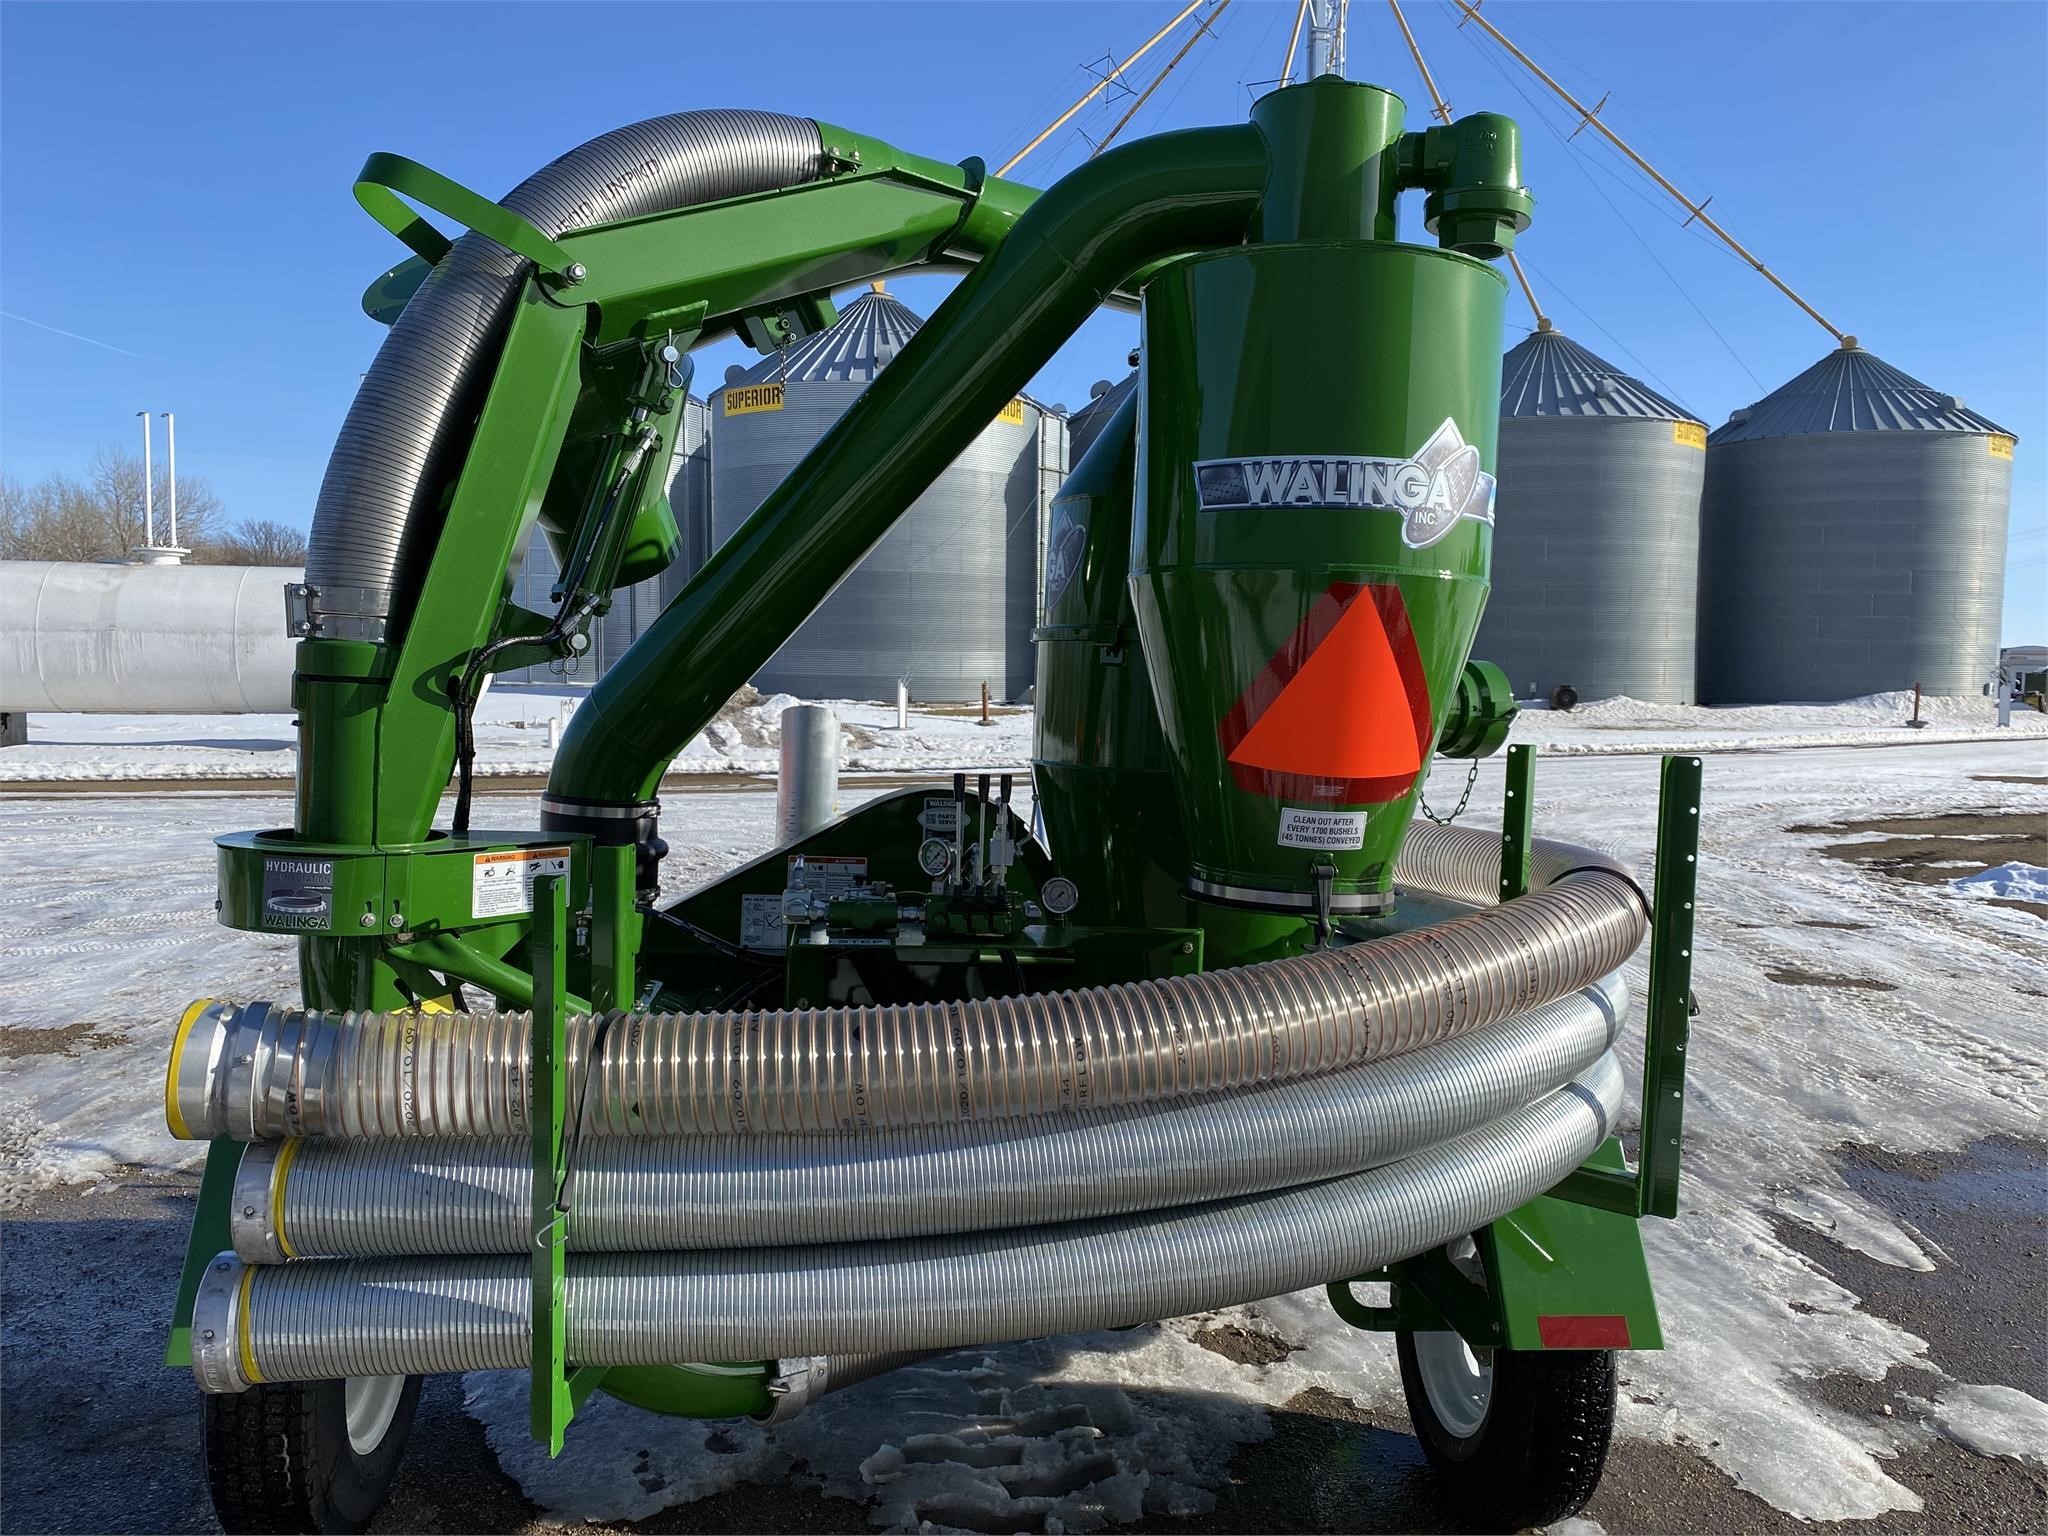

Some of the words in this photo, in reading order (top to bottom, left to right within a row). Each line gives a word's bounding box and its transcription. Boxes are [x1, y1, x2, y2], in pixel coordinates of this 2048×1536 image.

[727, 387, 780, 410] SUPERIOR
[1243, 460, 1454, 512] WALINGA
[1414, 513, 1438, 526] INC.
[1293, 815, 1316, 825] CLEAN
[1318, 818, 1331, 826] OUT
[1333, 818, 1354, 826] AFTER
[1287, 824, 1310, 834] EVERY
[1329, 827, 1359, 835] BUSHELS
[1281, 832, 1294, 841] (45
[1296, 834, 1325, 845] TONNES)
[1326, 836, 1361, 844] CONVEYED
[266, 860, 331, 874] HYDRAULIC
[264, 913, 330, 929] WALINGA
[403, 1027, 415, 1127] 2020/10/09
